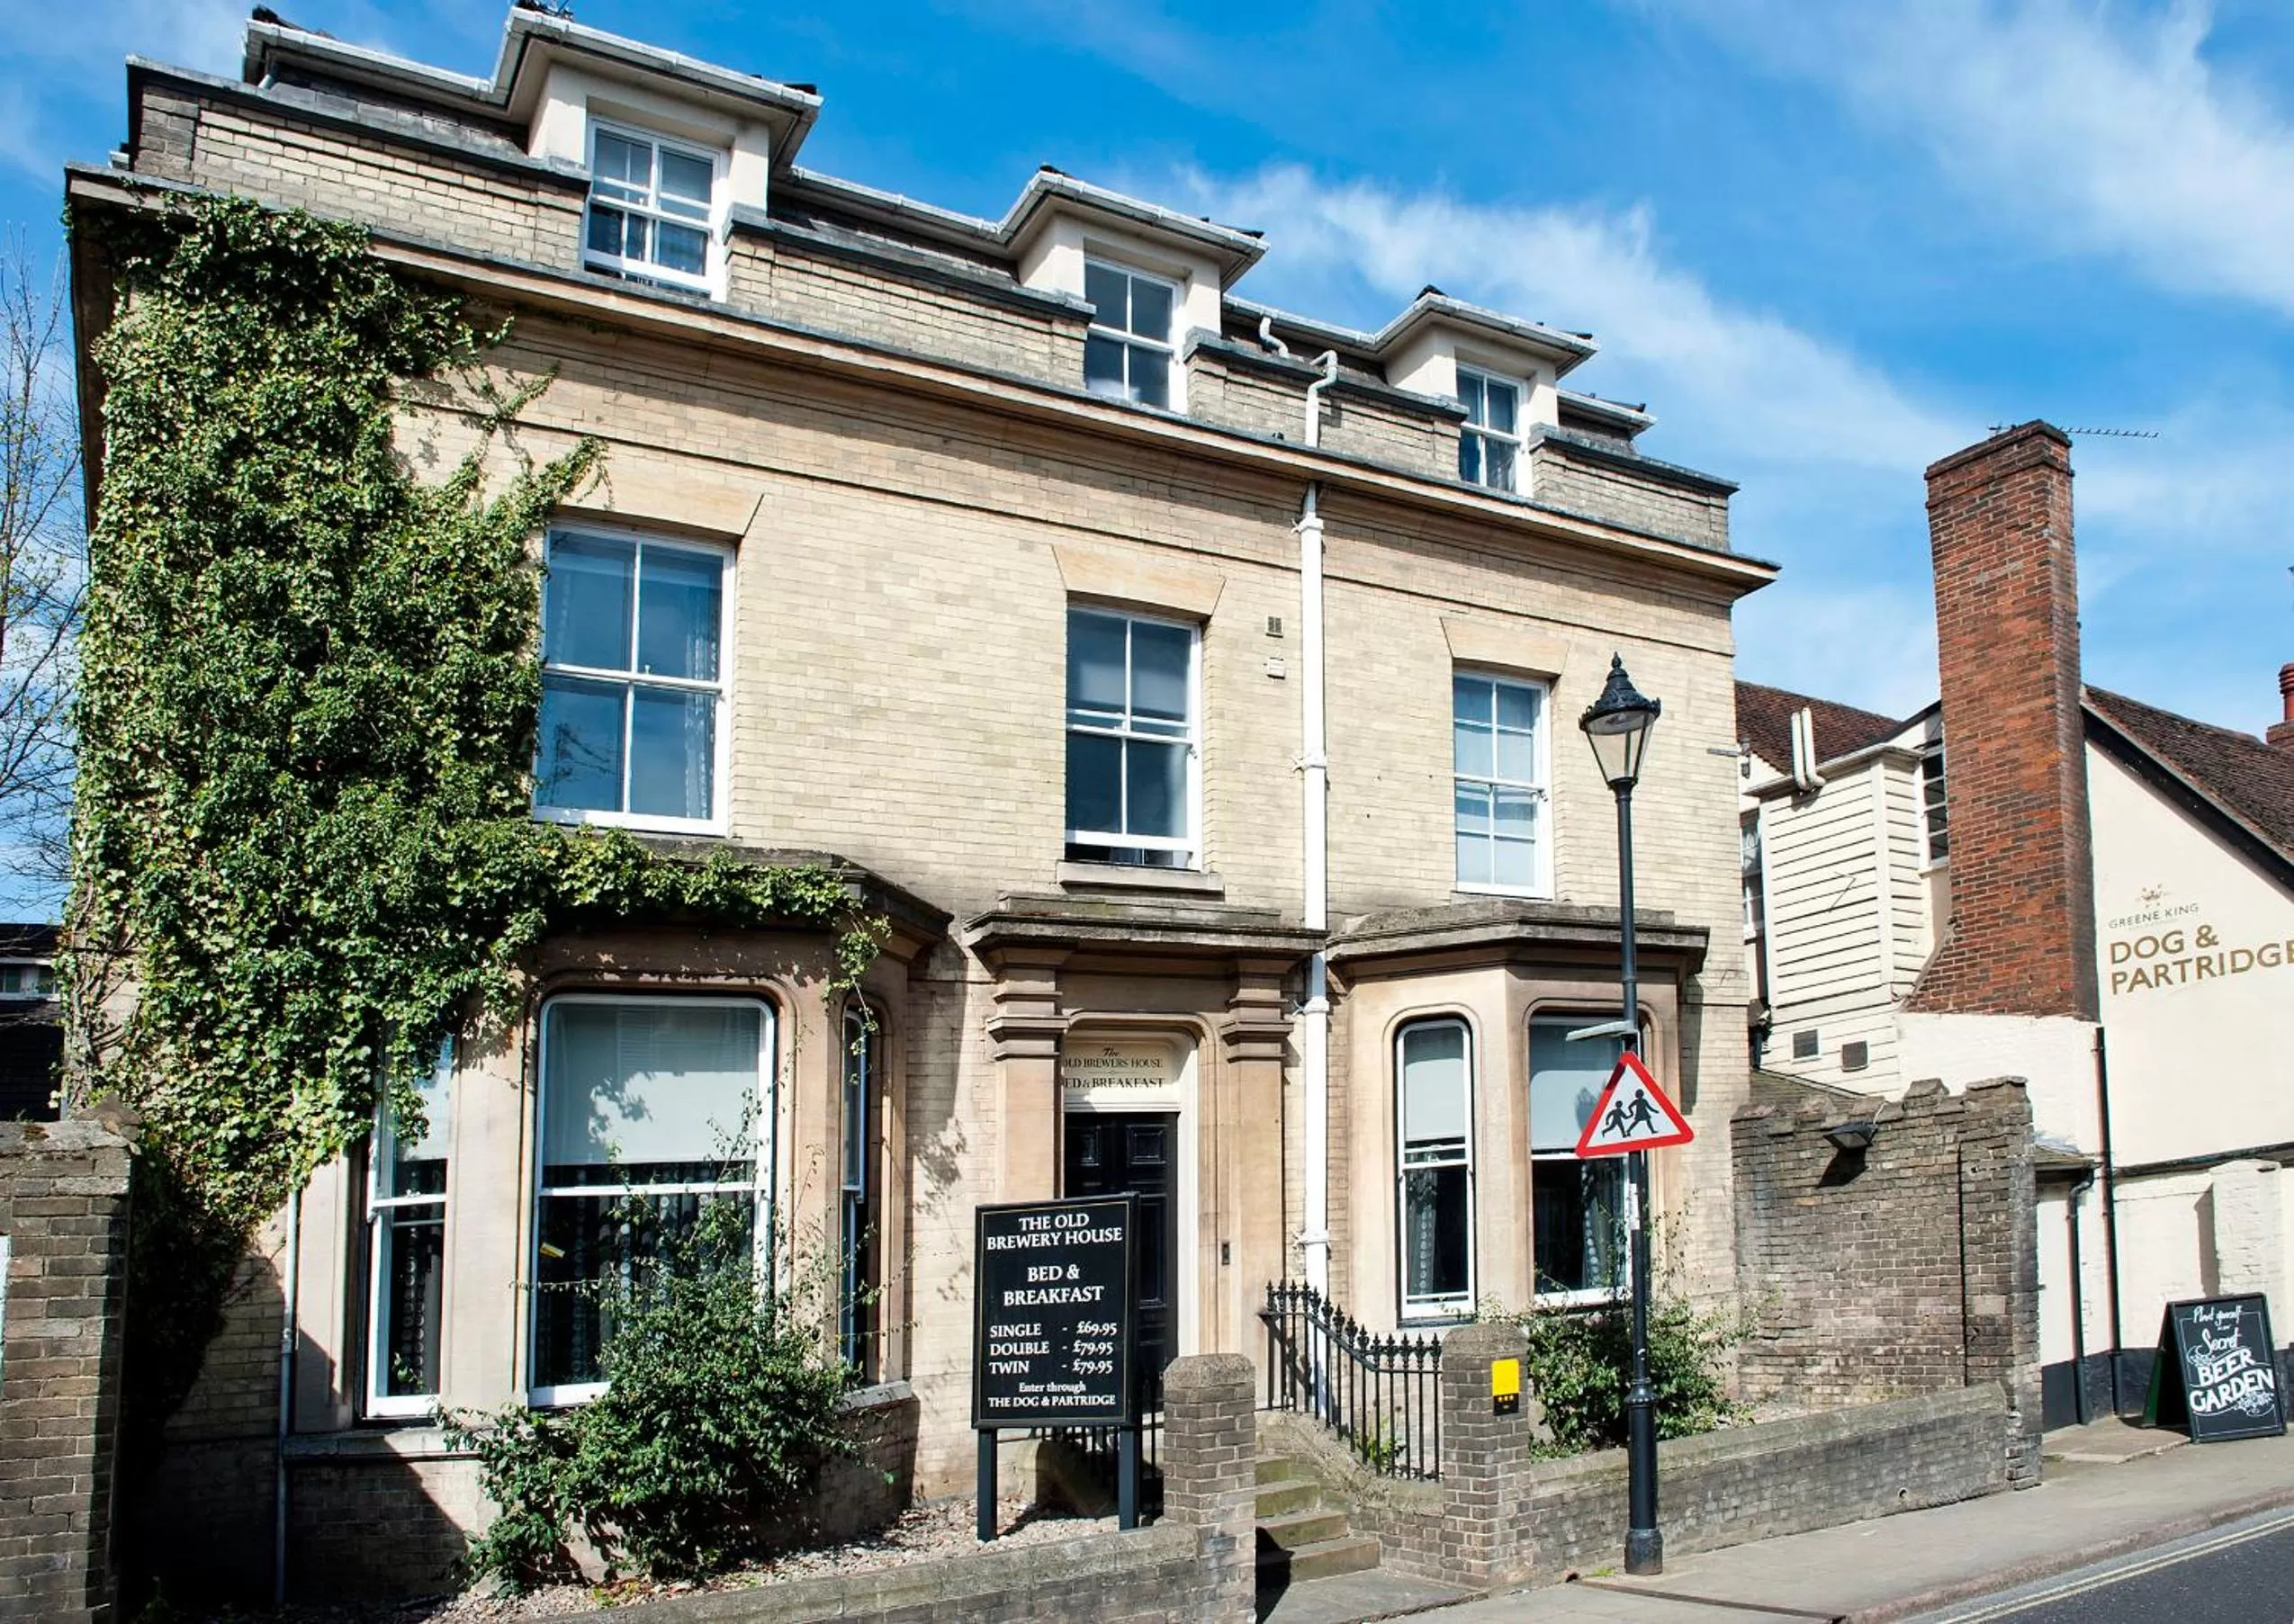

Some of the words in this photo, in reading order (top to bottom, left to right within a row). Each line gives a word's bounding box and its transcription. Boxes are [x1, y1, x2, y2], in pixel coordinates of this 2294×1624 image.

[2109, 911, 2161, 929] GREENE
[2164, 902, 2200, 919] KING
[2110, 929, 2185, 965] DOG
[2195, 924, 2219, 949] &
[1102, 1047, 1120, 1056] The
[1131, 1056, 1163, 1068] HOUSE
[1092, 1077, 1165, 1089] BREAKFAST
[1019, 1216, 1051, 1231] THE
[1055, 1214, 1090, 1228] OLD
[987, 1232, 1061, 1251] BREWERY
[1065, 1227, 1123, 1246] HOUSE
[1027, 1265, 1063, 1283] BED
[1066, 1264, 1080, 1280] &
[1003, 1286, 1105, 1306] BREAKFAST
[990, 1323, 1042, 1338] SINGLE
[1076, 1321, 1117, 1337] £69.95
[990, 1341, 1049, 1357] DOUBLE
[1073, 1341, 1113, 1356] £79.95
[2195, 1327, 2242, 1357] Secret
[989, 1360, 1030, 1375] TWIN
[1072, 1359, 1113, 1374] £79.95
[2197, 1349, 2255, 1386] BEER
[1019, 1383, 1045, 1393] Enter
[1047, 1382, 1087, 1395] through
[2189, 1368, 2275, 1413] GARDEN
[988, 1397, 1011, 1408] THE
[1012, 1396, 1039, 1408] DOG
[1041, 1396, 1050, 1406] &
[1051, 1395, 1117, 1407] PARTRIDGE
